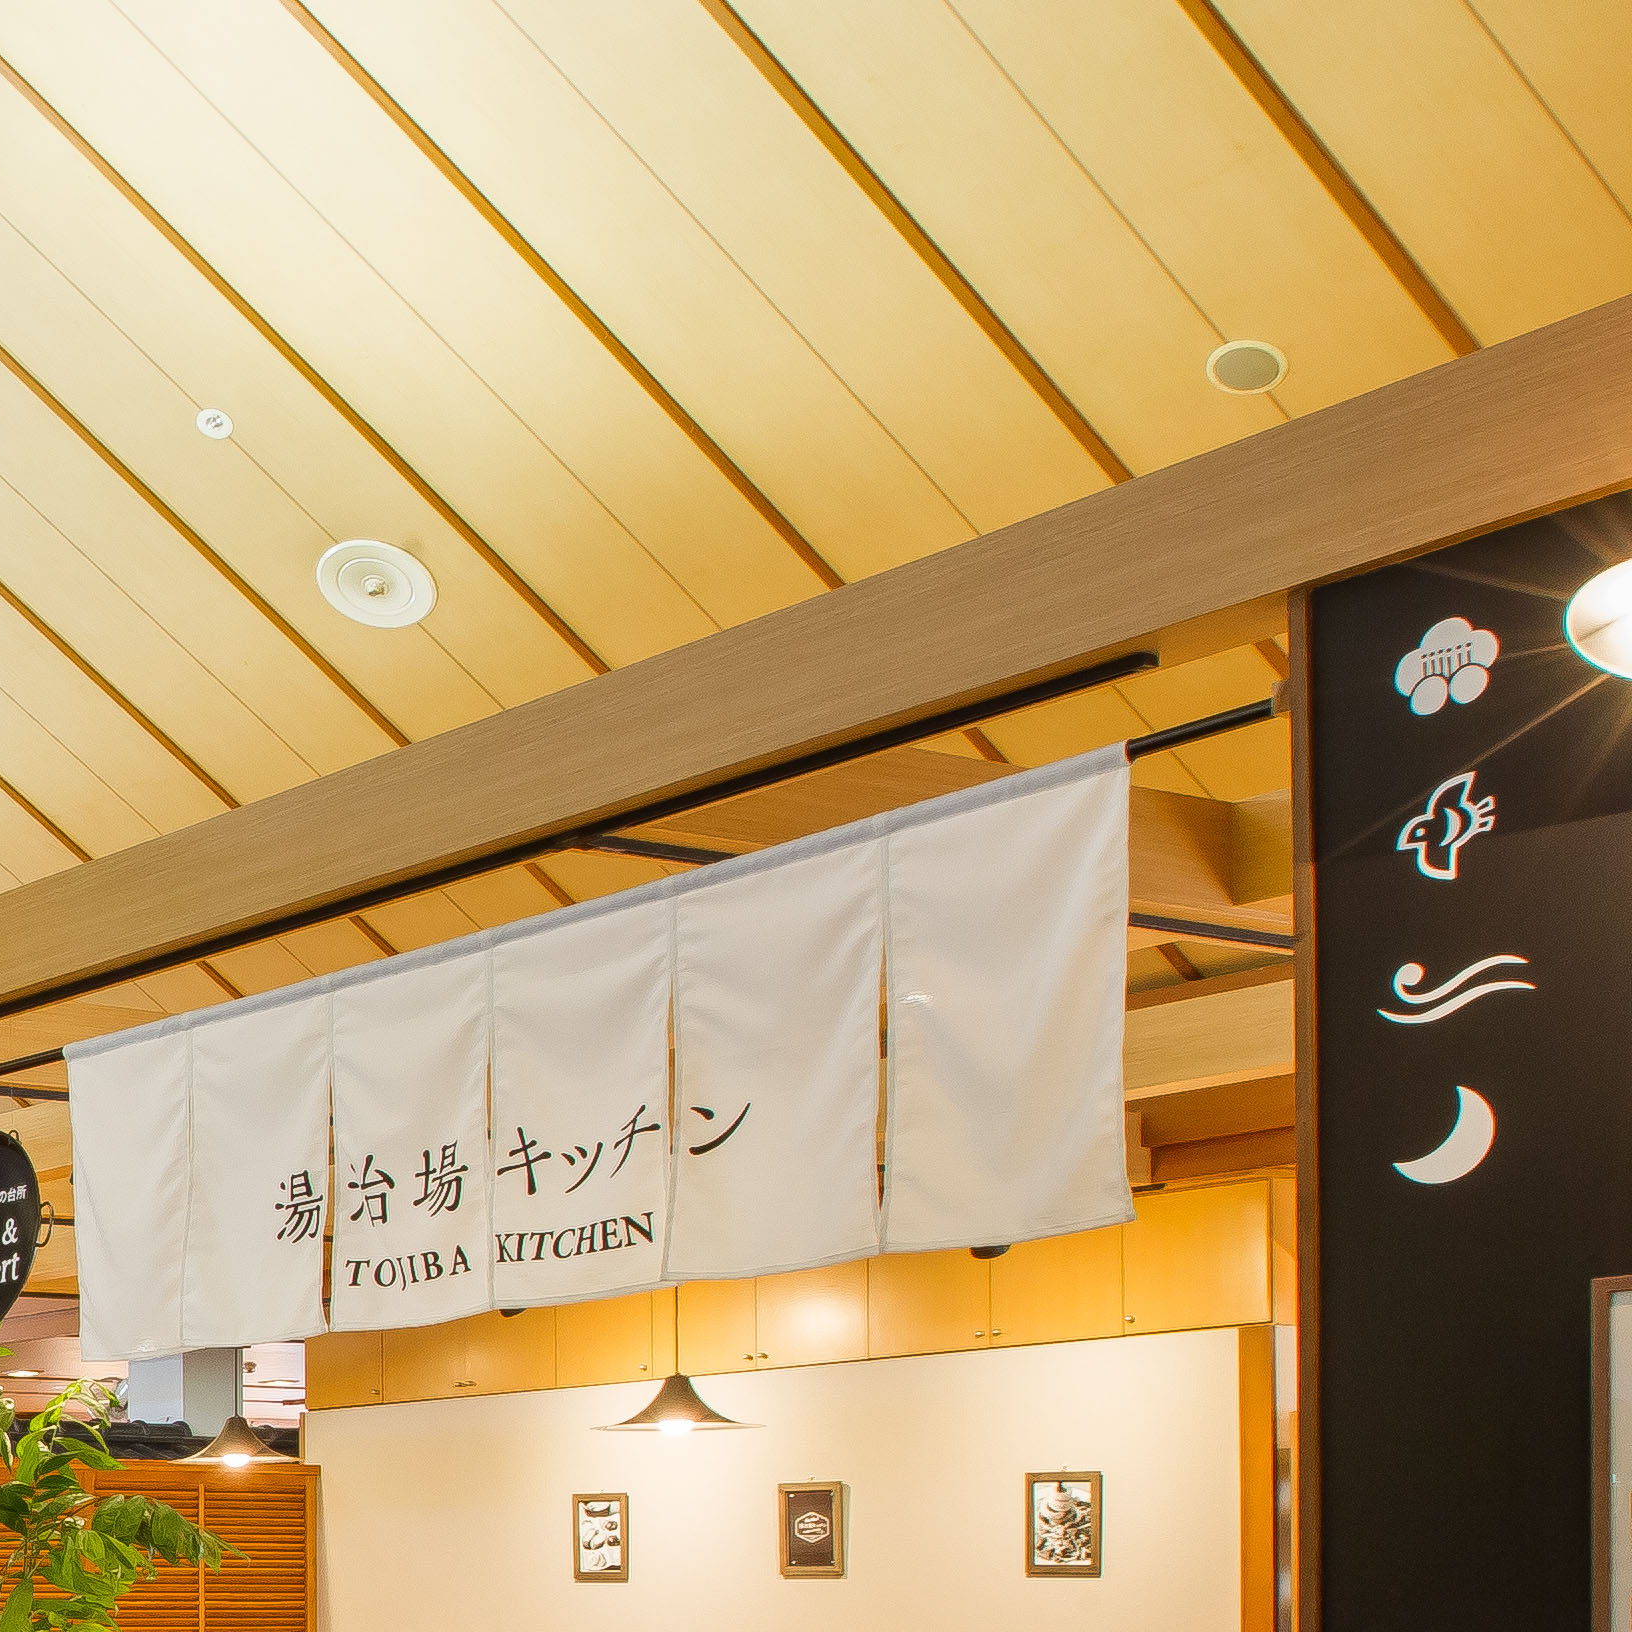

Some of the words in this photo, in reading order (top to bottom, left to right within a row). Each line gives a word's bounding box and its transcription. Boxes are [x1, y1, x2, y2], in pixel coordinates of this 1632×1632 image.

[275, 1102, 751, 1244] 湯治場キッチン
[1, 1217, 19, 1246] &
[345, 1244, 471, 1291] TOJIBA
[495, 1211, 654, 1263] KITCHEN
